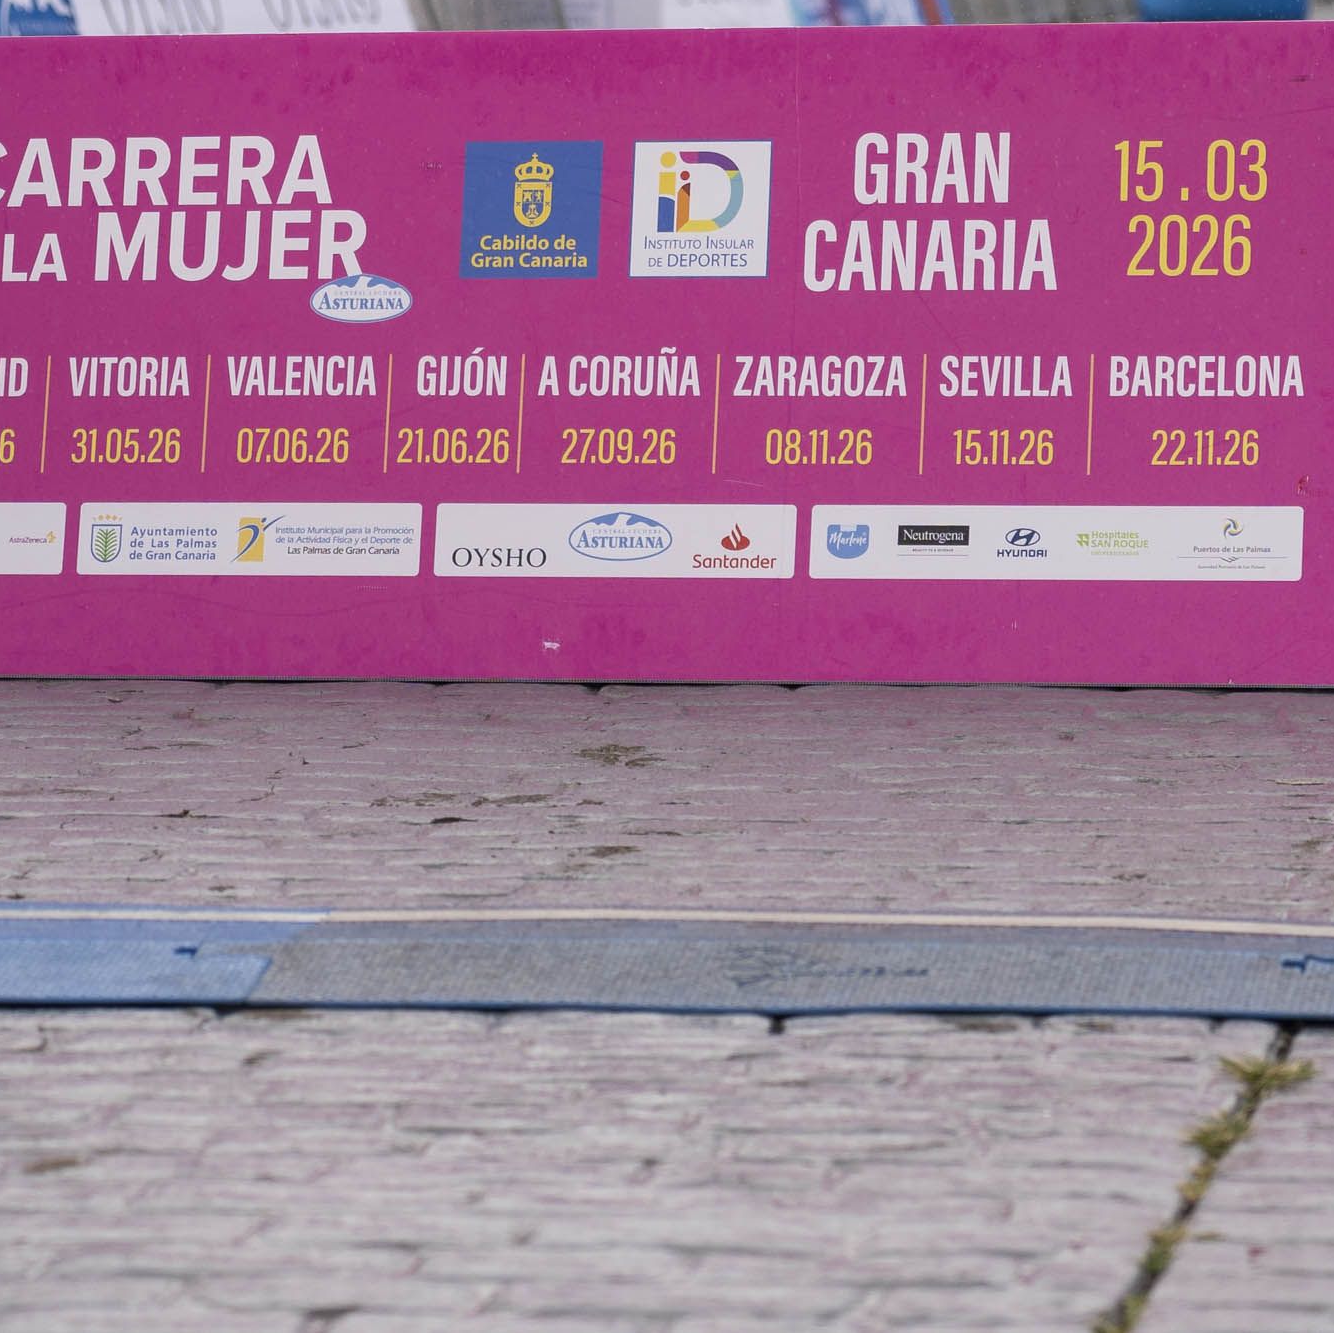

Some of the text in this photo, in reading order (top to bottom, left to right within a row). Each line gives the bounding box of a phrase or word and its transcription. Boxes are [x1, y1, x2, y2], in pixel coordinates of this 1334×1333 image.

[854, 132, 1010, 205] GRAN
[1, 233, 68, 283] LA
[94, 210, 368, 282] MUJER
[480, 233, 576, 251] Cabildo de
[1127, 214, 1251, 277] 2026
[471, 251, 587, 268] Gran Canaria
[648, 253, 747, 267] DE DEPORTES
[803, 219, 1057, 292] CANARIA
[319, 292, 404, 311] ASTURIANA
[70, 356, 189, 397] VITORIA
[228, 356, 377, 397] VALENCIA
[416, 347, 507, 397] GIJÓN
[538, 348, 701, 398] A CORUÑA
[734, 356, 907, 398] ZARAGOZA
[939, 356, 1072, 398] SEVILLA
[1108, 356, 1304, 398] BARCELONA
[70, 428, 181, 465] 31.05.26
[236, 428, 349, 465] 07.06.26
[396, 428, 509, 465] 21.06.26
[562, 428, 676, 466] 27.09.26
[765, 428, 873, 466] 08.11.26
[954, 428, 1054, 466] 15.11.26
[1152, 428, 1259, 467] 22.11.26
[9, 536, 47, 544] AstraZeneca
[131, 526, 217, 538] Ayuntamiento
[275, 526, 306, 535] Instituto
[308, 526, 343, 537] Municipal
[346, 527, 363, 537] para
[373, 525, 415, 535] Promoción
[276, 535, 285, 544] de
[296, 535, 330, 544] Actividad
[332, 535, 352, 544] Física
[361, 535, 368, 544] el
[370, 535, 401, 547] Deporte
[404, 535, 413, 544] de
[577, 529, 664, 549] ASTURIANA
[829, 532, 867, 551] Marlene
[903, 529, 965, 543] Neutrogena
[1092, 531, 1139, 541] Hospitales
[130, 537, 217, 550] de Las Palmas
[287, 546, 400, 555] Las Palmas de Gran Canaria
[997, 549, 1047, 558] HYUNDAI
[1091, 540, 1148, 548] SAN ROQUE
[129, 550, 216, 561] de Gran Canaria
[452, 547, 547, 568] OYSHO
[692, 554, 777, 569] Santander
